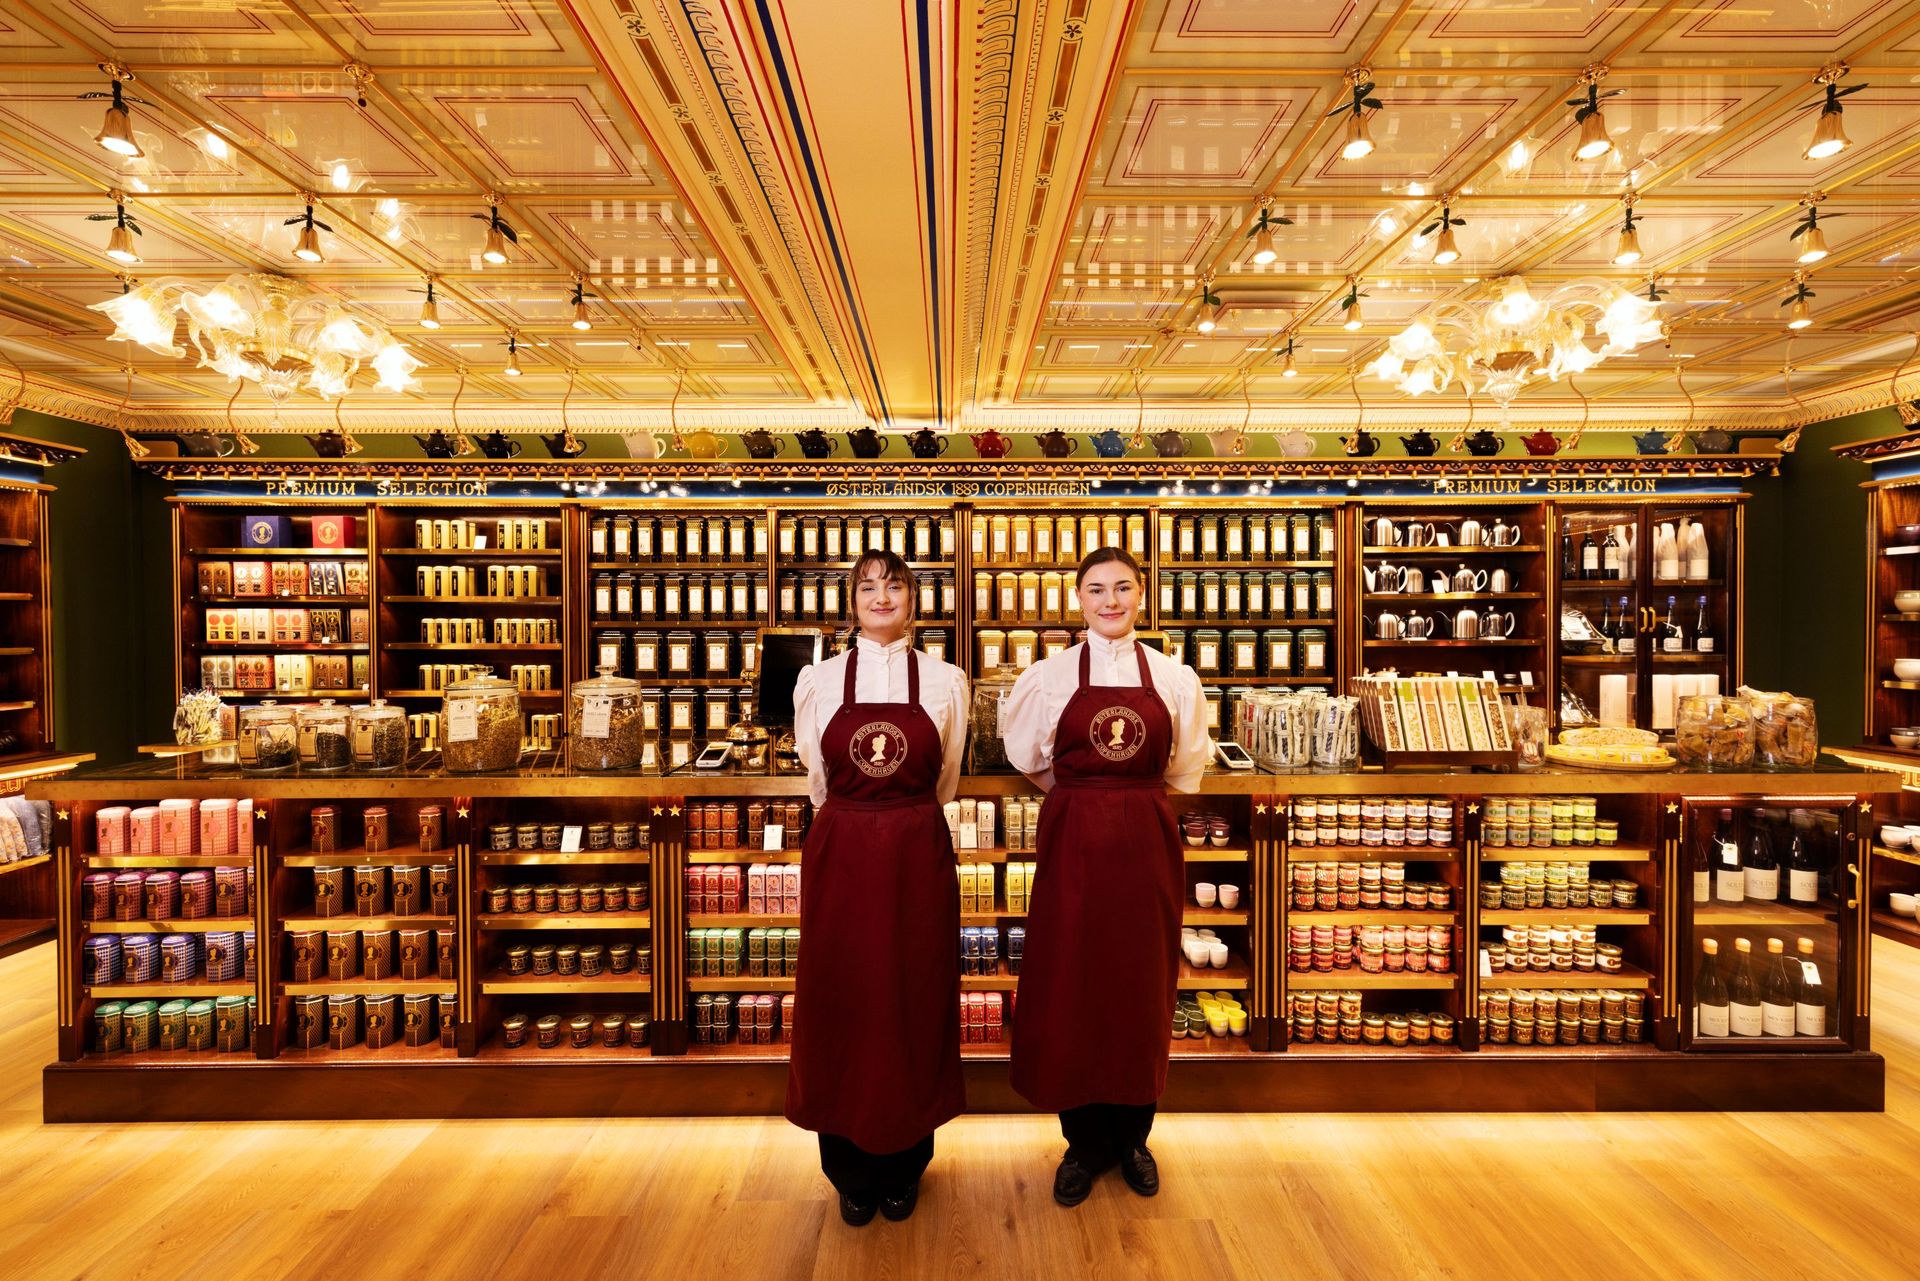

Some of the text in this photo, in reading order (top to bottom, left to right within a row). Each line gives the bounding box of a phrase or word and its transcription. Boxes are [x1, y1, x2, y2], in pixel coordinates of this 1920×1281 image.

[266, 482, 488, 496] PREMIUM SELECTION
[825, 482, 1091, 498] ØSTERLANDSK 1889 COPENHAGEN
[1433, 479, 1657, 494] PREMIUM SELECTION
[1097, 742, 1138, 760] COPENHAGEN
